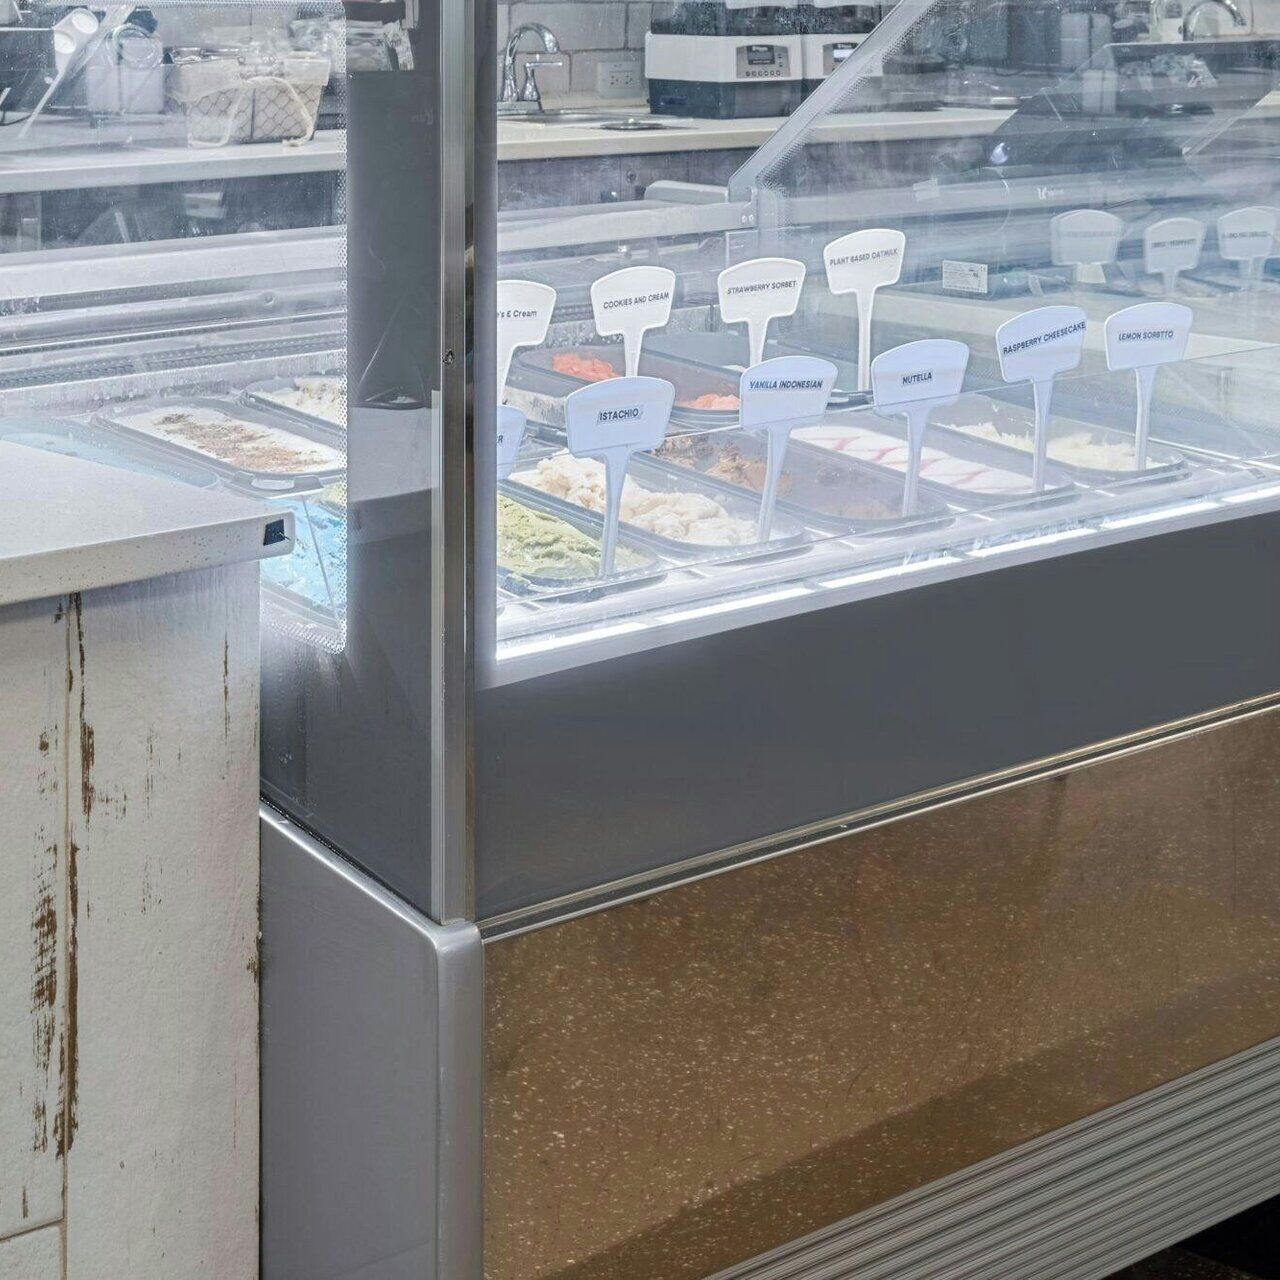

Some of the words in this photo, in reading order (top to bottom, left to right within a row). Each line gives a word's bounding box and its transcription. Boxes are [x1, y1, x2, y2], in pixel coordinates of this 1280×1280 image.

[830, 256, 850, 267] PLANT
[850, 253, 870, 263] BASED
[871, 248, 898, 260] OATMILK
[727, 283, 770, 295] STRAWBERRY
[770, 280, 797, 290] SORBET
[603, 298, 633, 310] COOKIES
[634, 296, 647, 305] AND
[648, 292, 670, 303] CREAM
[513, 310, 537, 318] Cream
[1002, 336, 1042, 355] RASPBERRY
[1043, 321, 1087, 343] CHEESECAKE
[1118, 331, 1142, 342] LEMON
[749, 381, 778, 389] VANILLA
[778, 380, 824, 390] INDONESIAN
[902, 371, 933, 385] NUTELLA
